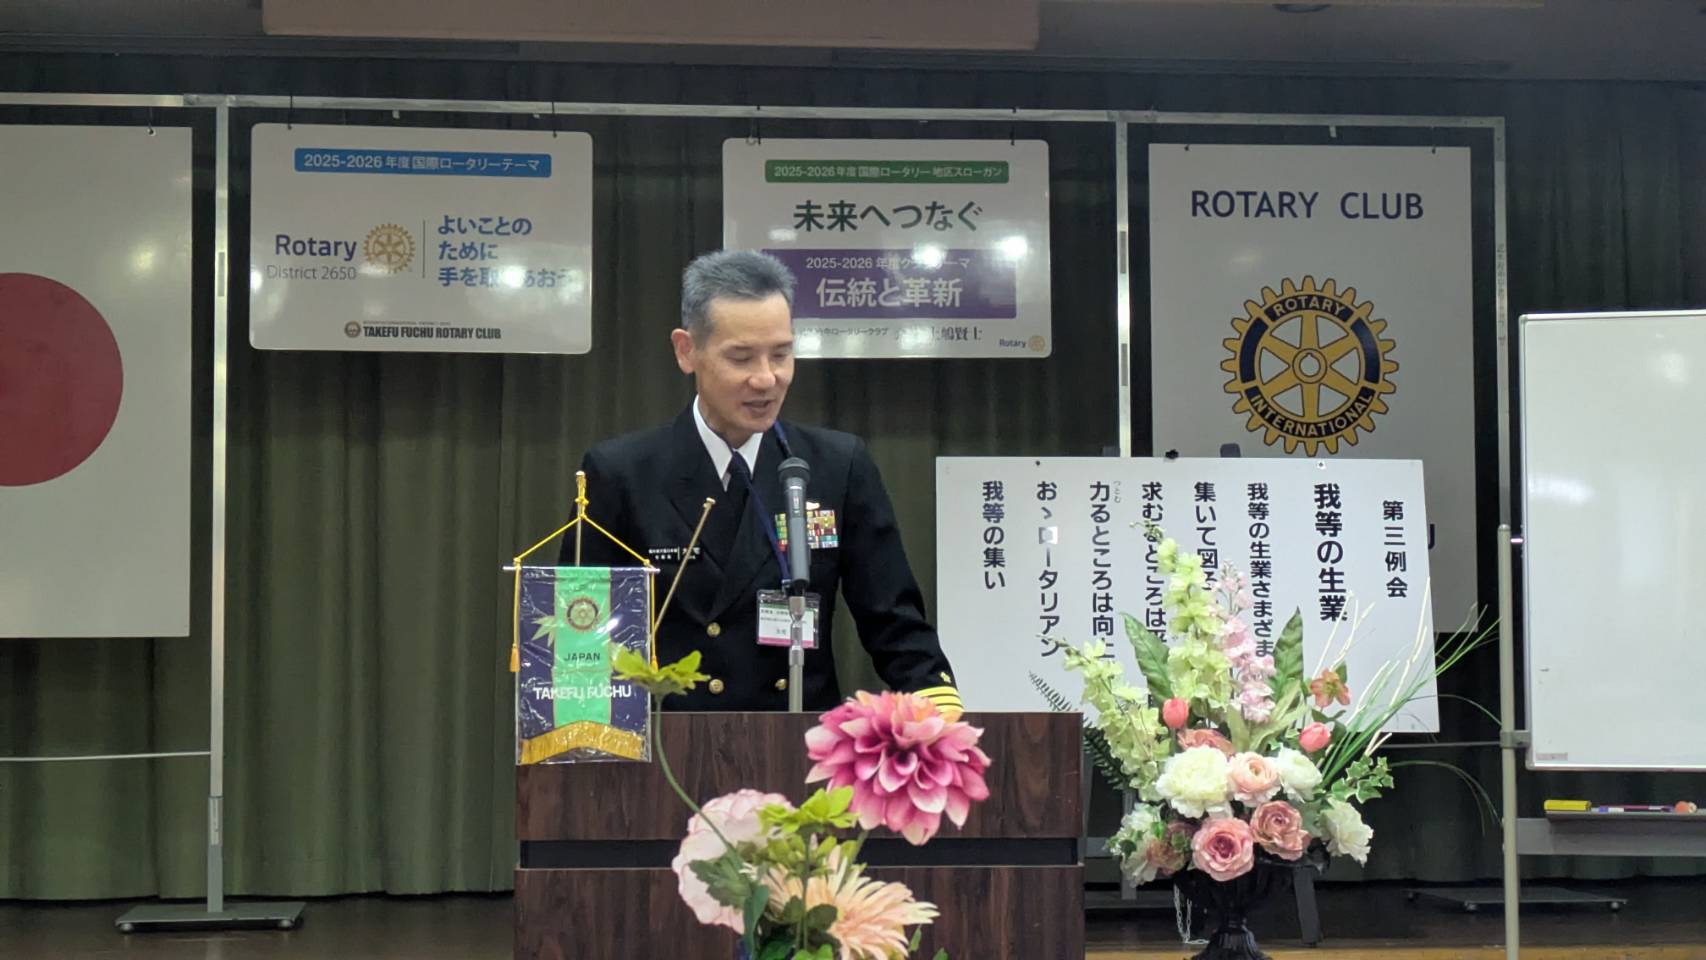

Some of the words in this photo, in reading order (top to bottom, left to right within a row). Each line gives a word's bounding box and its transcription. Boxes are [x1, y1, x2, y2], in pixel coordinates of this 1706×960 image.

[793, 199, 984, 232] 未来へつなぐ
[1191, 190, 1319, 219] ROTARY
[1340, 192, 1424, 220] CLUB
[438, 215, 532, 236] よいことの
[275, 234, 357, 262] Rotary
[438, 240, 499, 260] ために
[266, 265, 318, 280] District
[321, 267, 357, 281] 2650
[816, 277, 963, 308] 伝統と革新
[1273, 296, 1347, 319] ROTARY
[363, 326, 399, 338] TAKEFU
[401, 326, 434, 338] FUCHU
[436, 327, 473, 339] ROTARY
[475, 328, 502, 339] CLUB
[999, 338, 1027, 349] Rotary
[1251, 394, 1373, 437] INTERNATIONAL
[982, 480, 1006, 590] 我等の集い
[1313, 483, 1348, 622] 我等の生業
[1382, 500, 1408, 598] 第三例会
[564, 652, 601, 662] JAPAN
[533, 686, 584, 700] TAKEFU
[587, 684, 632, 699] FUCHU
